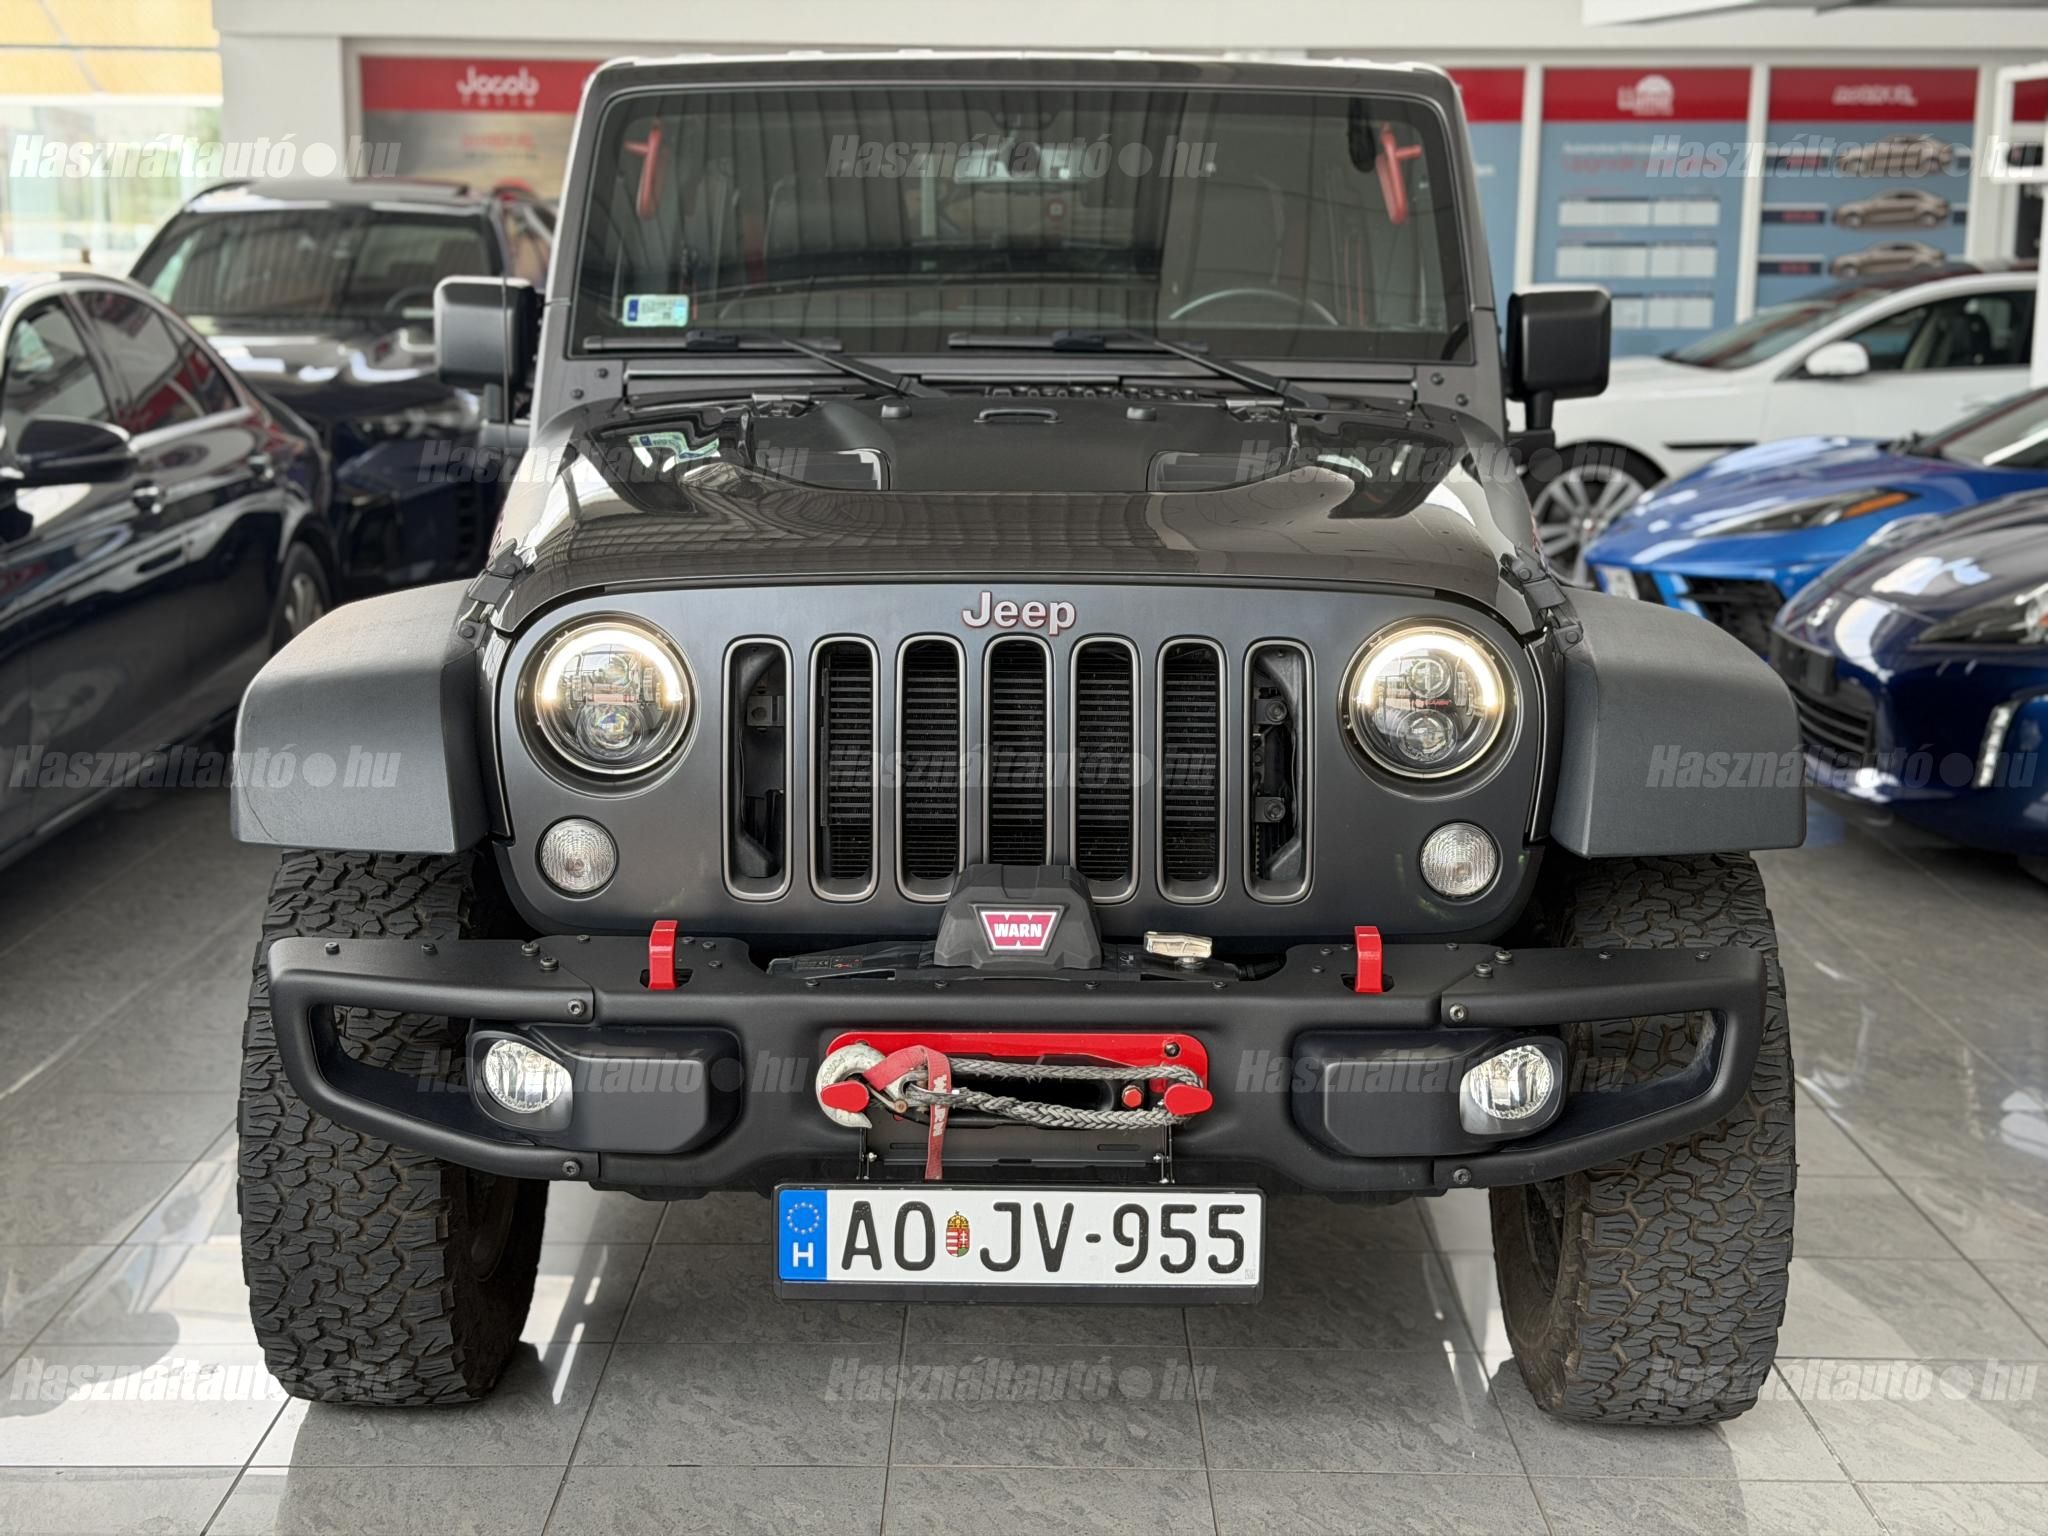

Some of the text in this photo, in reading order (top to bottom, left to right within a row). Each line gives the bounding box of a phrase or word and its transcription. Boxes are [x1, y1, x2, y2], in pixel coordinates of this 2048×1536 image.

[961, 590, 1077, 636] Jeep
[993, 923, 1043, 938] WARN
[932, 1074, 948, 1137] WRN
[792, 1242, 814, 1268] H
[841, 1200, 1245, 1274] AO JV-955
